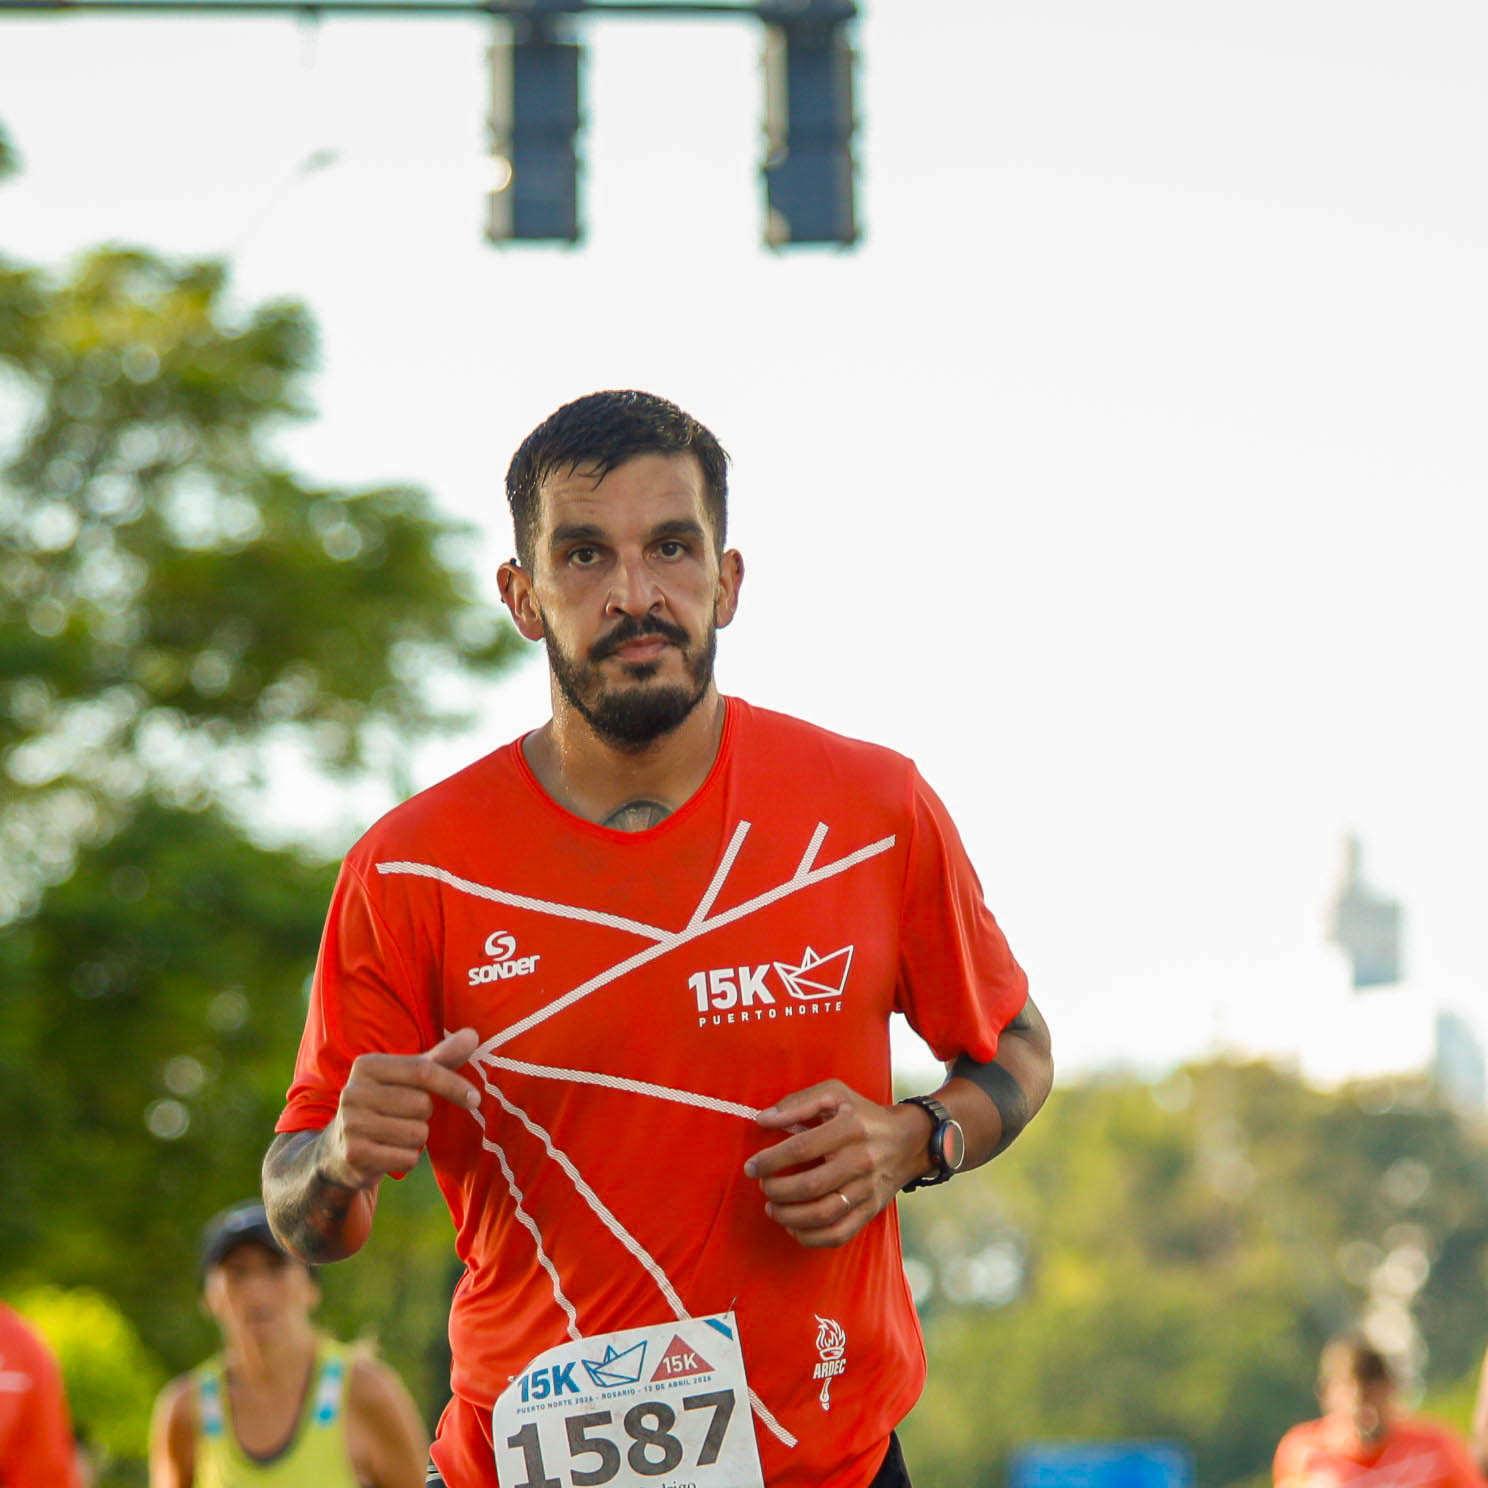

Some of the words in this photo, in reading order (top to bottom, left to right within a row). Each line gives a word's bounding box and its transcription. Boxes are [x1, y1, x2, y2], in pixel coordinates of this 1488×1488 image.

[687, 963, 777, 1013] 15K
[698, 1009, 777, 1028] PUERTO
[784, 1001, 843, 1017] NORTE
[661, 1352, 699, 1375] 15K
[813, 1358, 847, 1380] ARDEC
[516, 1403, 546, 1415] PUERTO
[547, 1398, 573, 1410] NORTE
[601, 1388, 636, 1400] ROSARIO
[655, 1383, 665, 1391] DE
[668, 1379, 691, 1389] ABRIL
[517, 1361, 581, 1404] 15K
